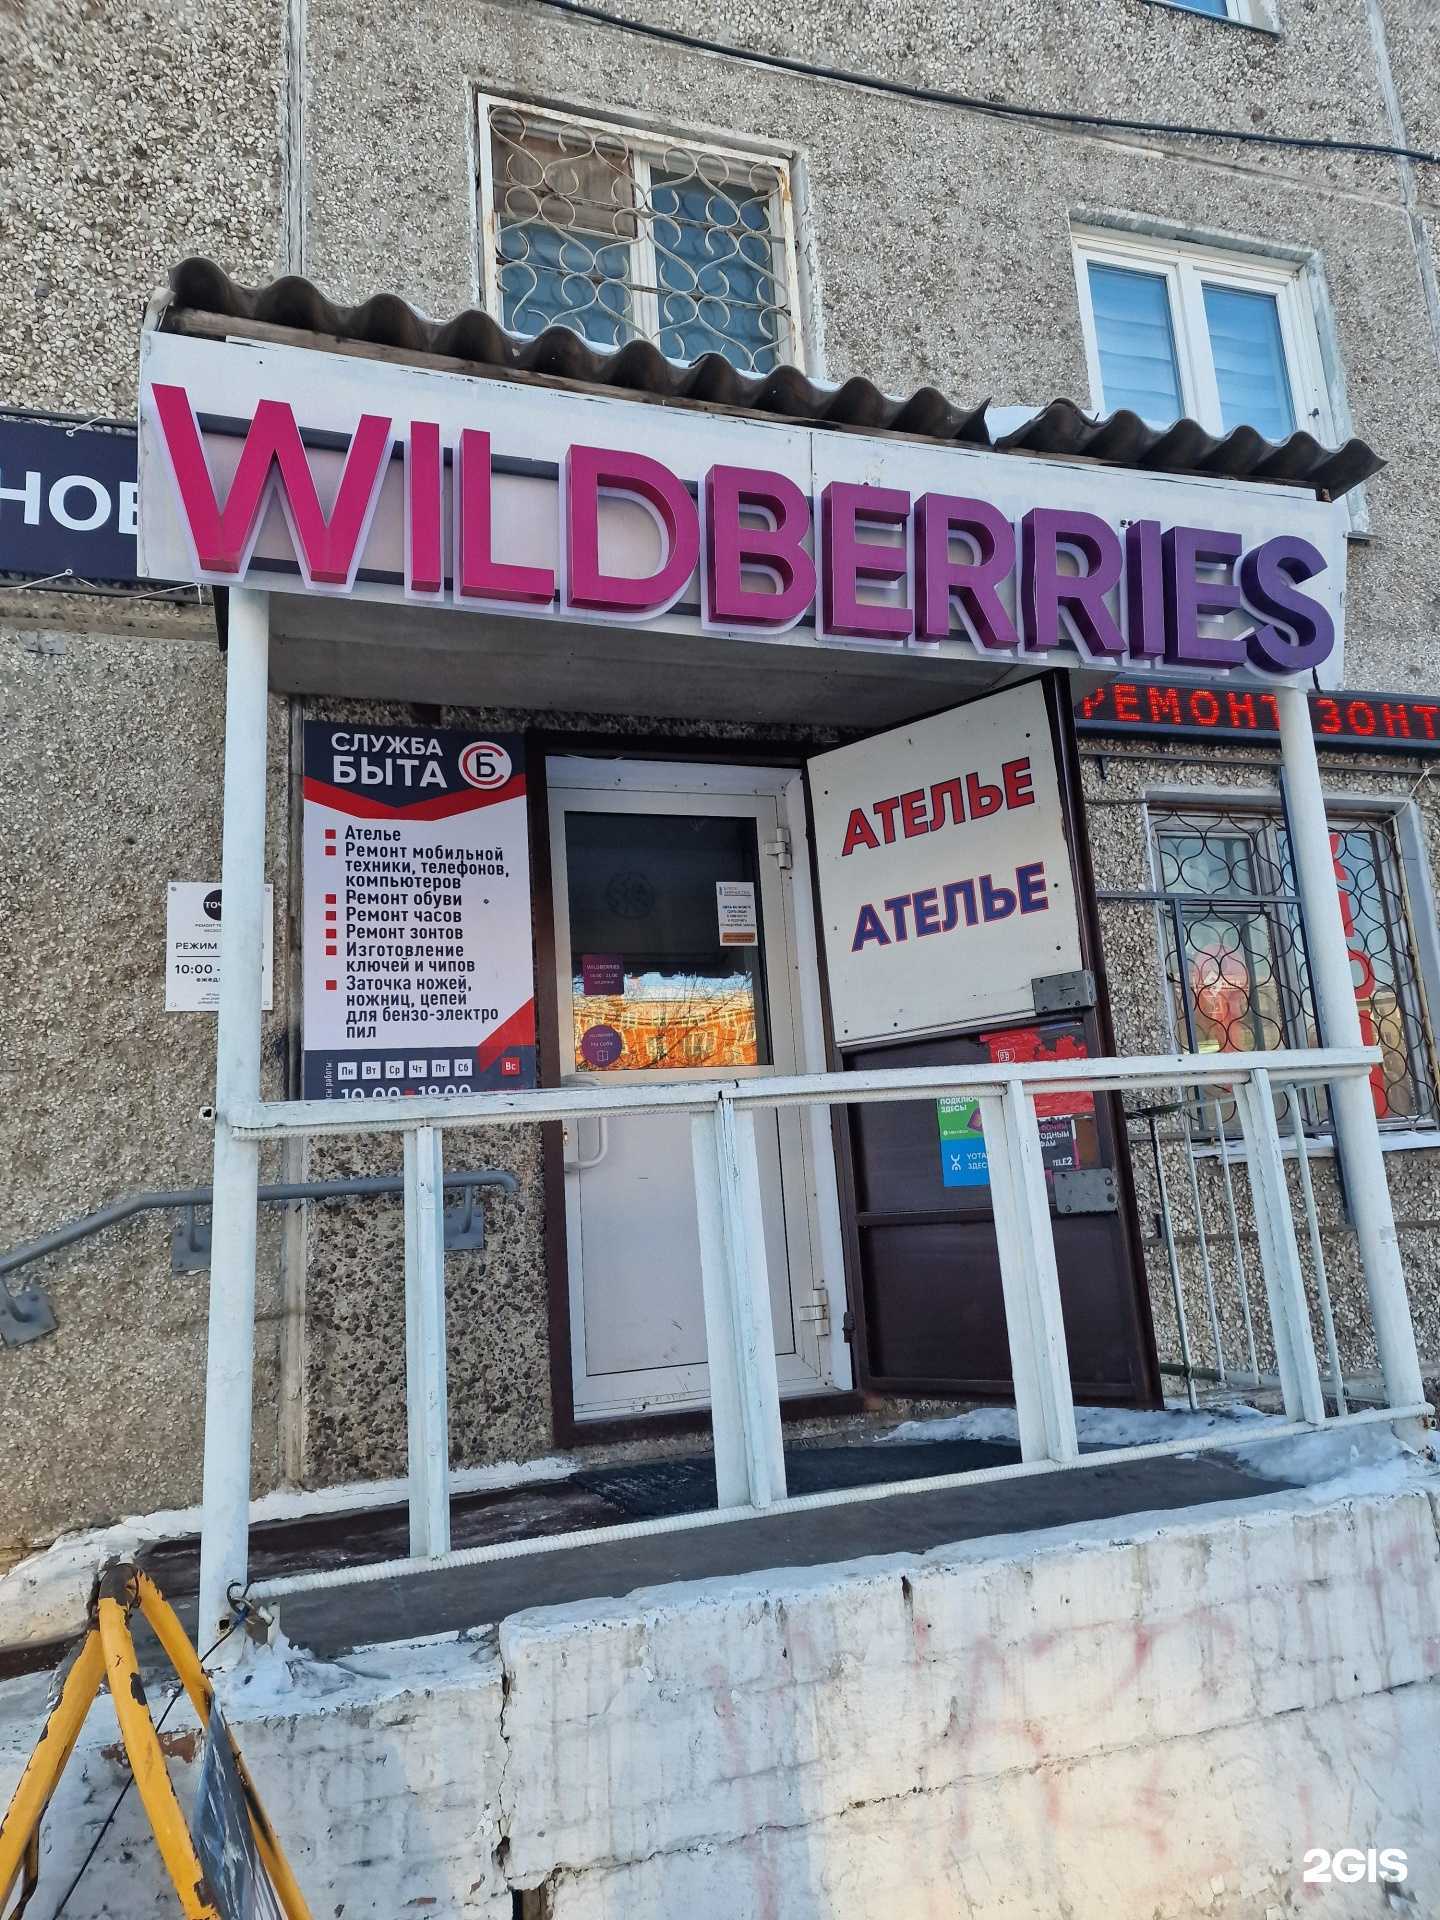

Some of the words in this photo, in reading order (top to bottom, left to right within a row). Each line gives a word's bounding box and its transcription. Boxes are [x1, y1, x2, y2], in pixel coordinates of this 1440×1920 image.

[151, 383, 1336, 674] WILDBERRIES
[331, 732, 443, 757] СЛУЖБА
[332, 756, 448, 788] БЫТА
[842, 756, 1035, 856] АТЕЛЬЕ
[345, 825, 401, 842] Ателье
[346, 842, 407, 859] Ремонт
[413, 845, 504, 861] мобильной
[345, 860, 416, 876] техники,
[421, 861, 510, 878] телефонов,
[346, 876, 461, 891] компьютеров
[346, 891, 410, 906] Ремонт
[413, 892, 462, 909] обуви
[851, 861, 1049, 952] АТЕЛЬЕ
[346, 907, 410, 922] Ремонт
[413, 910, 462, 923] часов
[346, 924, 405, 939] Ремонт
[411, 926, 463, 940] зонтов
[175, 942, 217, 950] РЕЖИМ
[346, 942, 464, 957] Изготовление
[175, 964, 212, 974] 10:00
[346, 958, 410, 974] ключей
[414, 961, 424, 973] и
[428, 960, 475, 974] чипов
[346, 976, 412, 991] Заточка
[416, 977, 472, 993] ножей,
[346, 994, 415, 1009] ножниц,
[420, 991, 467, 1008] цепей
[346, 1009, 377, 1025] для
[383, 1005, 499, 1023] бензо-электро
[346, 1026, 377, 1039] пил
[341, 1065, 353, 1075] Пн
[366, 1065, 376, 1075] Вт
[389, 1065, 400, 1076] Ср
[412, 1064, 423, 1074] Чт
[435, 1064, 446, 1073] Пт
[458, 1063, 468, 1072] Сб
[505, 1061, 516, 1071] Вс
[968, 1162, 988, 1170] ЗДЕС
[1052, 1156, 1072, 1166] TELE2
